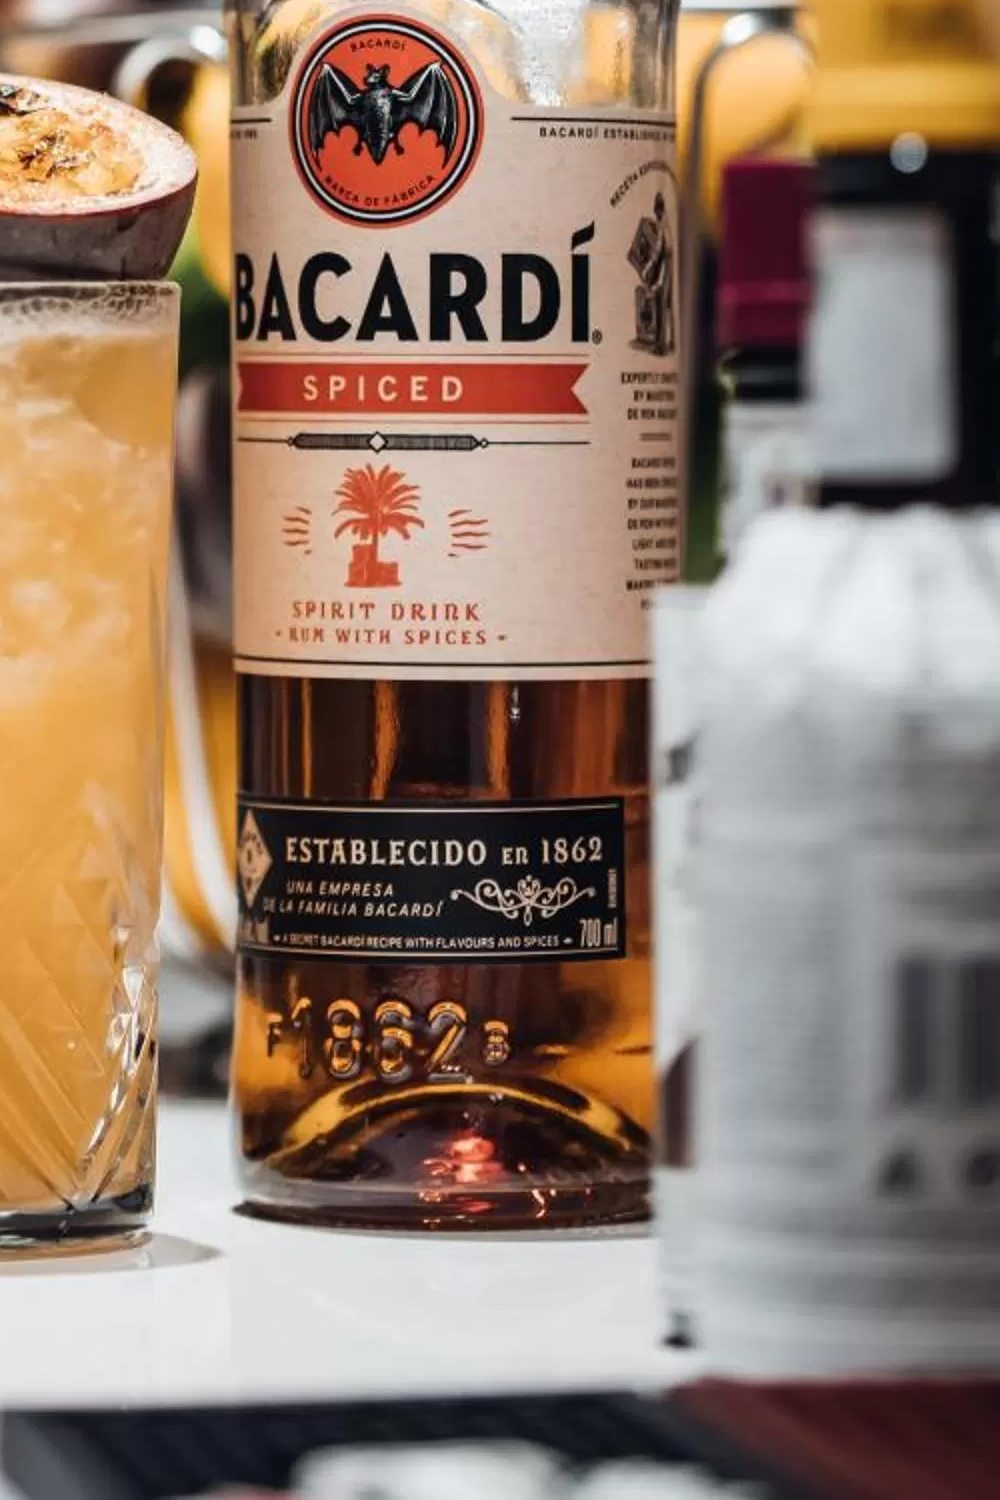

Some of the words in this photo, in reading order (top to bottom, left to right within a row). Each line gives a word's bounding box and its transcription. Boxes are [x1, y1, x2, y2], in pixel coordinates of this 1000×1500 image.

[365, 197, 379, 207] DE
[236, 221, 595, 343] BACARDÍ
[303, 375, 464, 402] SPICED
[292, 601, 375, 620] SPIRIT
[289, 627, 325, 643] RUM
[336, 628, 391, 644] WITH
[404, 630, 487, 645] SPICES
[285, 836, 487, 867] ESTABLECIDO
[541, 836, 603, 864] 1862
[286, 880, 313, 895] UNA
[319, 881, 395, 898] EMPRESA
[279, 899, 294, 913] LA
[298, 899, 358, 917] FAMILIA
[364, 901, 445, 917] BACARDÍ
[579, 918, 601, 948] 700
[604, 916, 618, 946] ml
[366, 935, 403, 949] RECIPE
[405, 936, 433, 949] WITH
[436, 937, 495, 949] FLAVOURS
[498, 936, 521, 948] AND
[524, 934, 559, 948] SPICES
